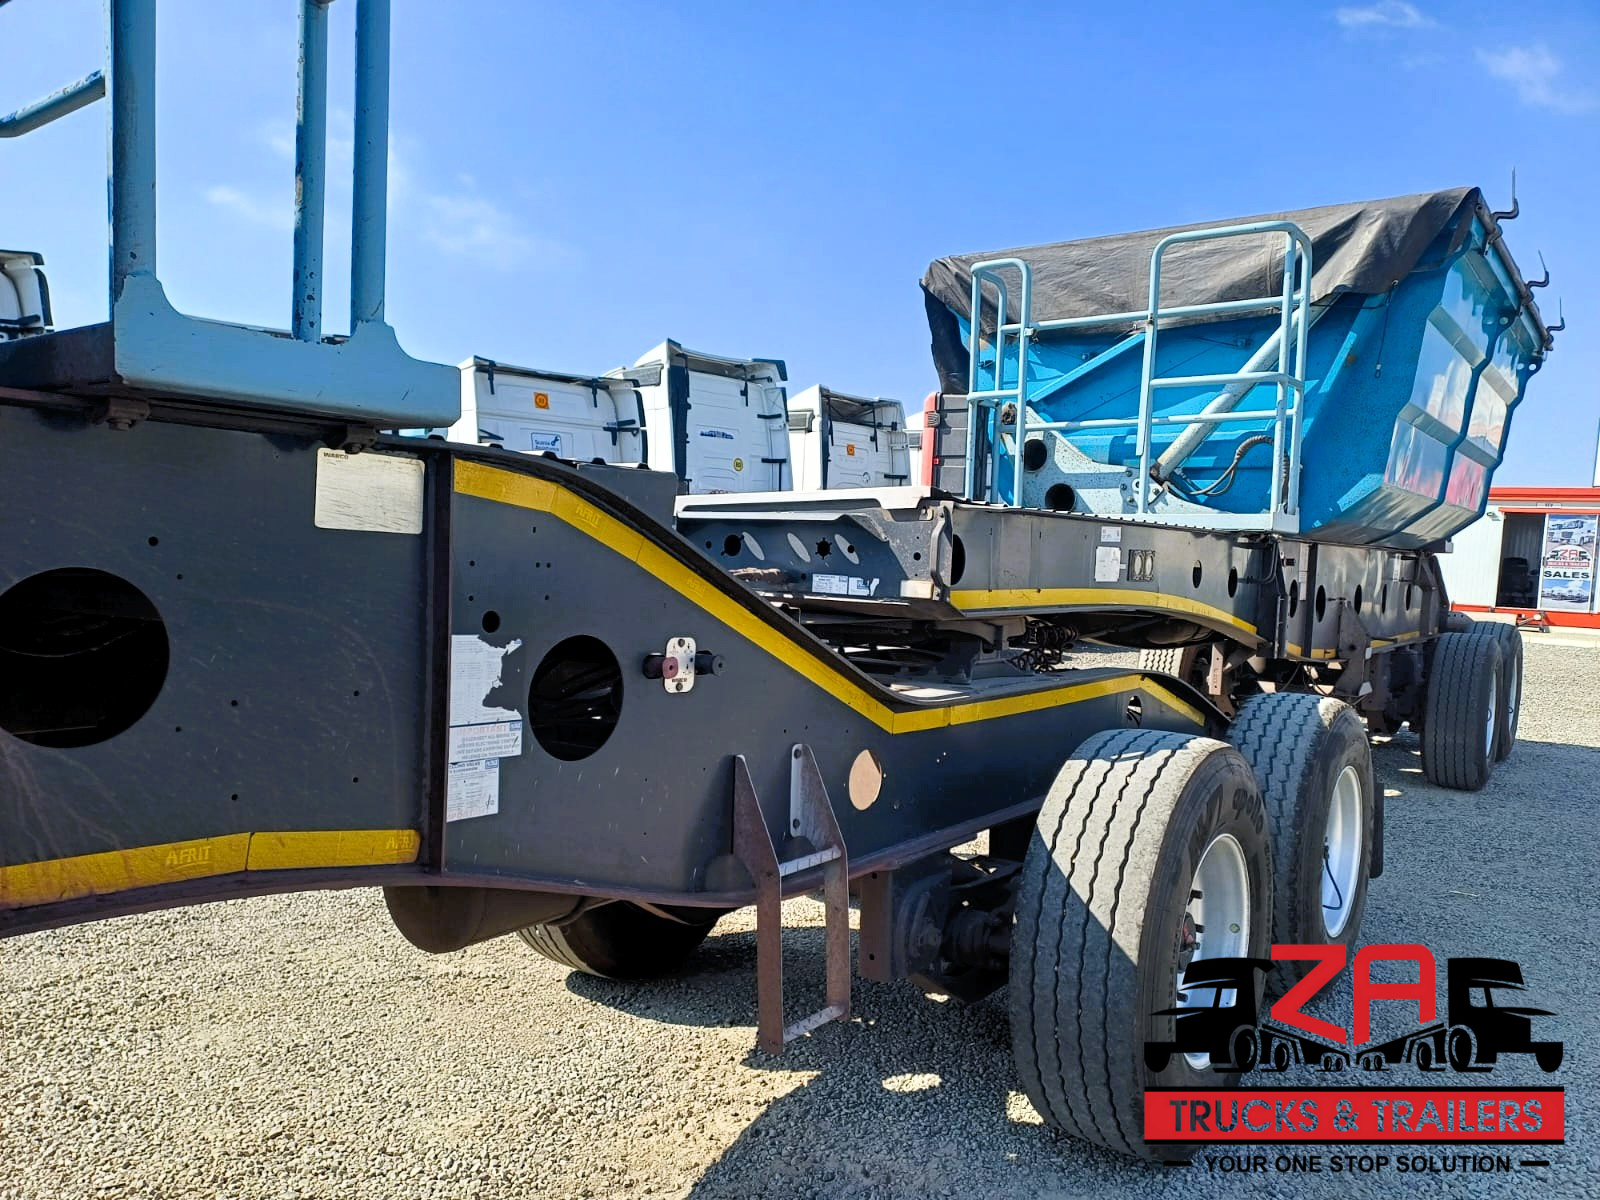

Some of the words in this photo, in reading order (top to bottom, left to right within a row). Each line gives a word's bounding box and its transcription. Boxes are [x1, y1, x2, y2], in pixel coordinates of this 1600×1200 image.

[1560, 549, 1578, 559] ZA
[1543, 570, 1590, 579] SALES
[166, 846, 212, 865] AFRIT
